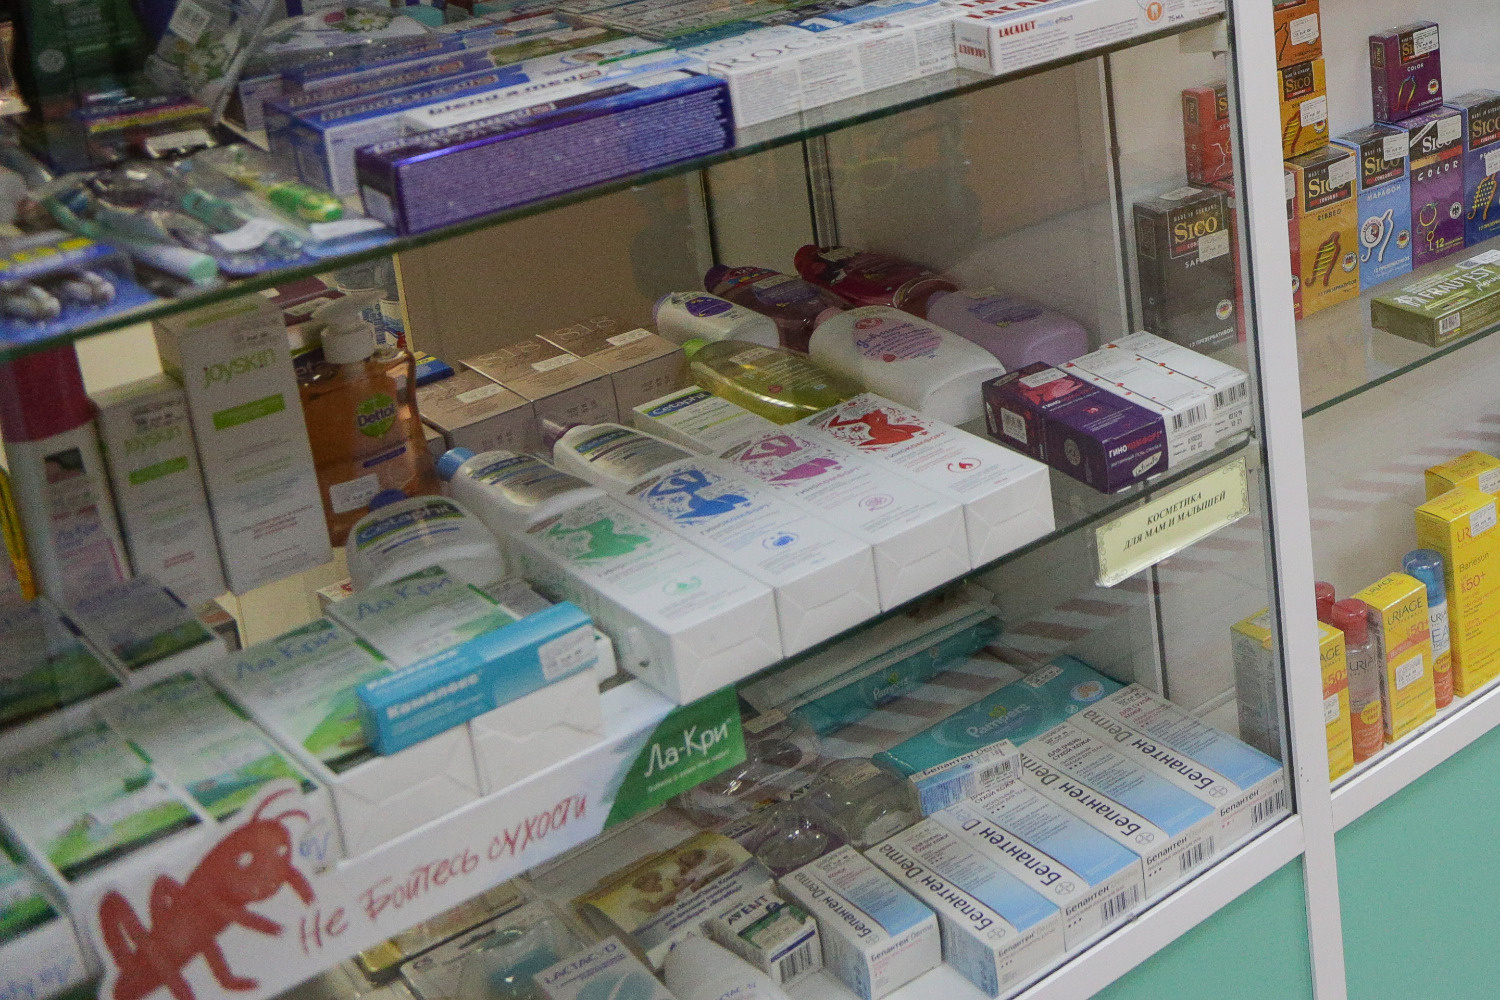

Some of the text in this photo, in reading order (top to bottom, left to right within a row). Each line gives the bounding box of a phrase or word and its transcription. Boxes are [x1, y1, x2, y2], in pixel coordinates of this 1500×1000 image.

[999, 20, 1036, 37] LACALUT
[1407, 63, 1424, 72] COLOR
[1417, 160, 1458, 182] COLOR
[1174, 216, 1217, 244] SICO
[1317, 209, 1342, 221] RIBBED
[1421, 267, 1496, 300] FRAUTEST
[356, 402, 397, 428] Dettol
[1123, 490, 1227, 551] ДЛЯ МАМ И МАЛЫШЕЙ
[1147, 491, 1202, 525] КОСМЕТИКА
[1387, 597, 1423, 626] URIAGE
[966, 703, 1031, 739] Pampers
[644, 719, 729, 778] Ла-Кри
[1083, 708, 1214, 788] Бепантен Derma
[1059, 771, 1144, 836] Бепантен
[1218, 787, 1261, 818] Бепантен
[979, 816, 1063, 886] Бепантен
[1145, 834, 1188, 866] Бепантен
[300, 792, 588, 955] Не Бойтесь сухости
[877, 843, 994, 934] Бепантен Derma
[1065, 884, 1111, 919] Бепантен
[819, 895, 872, 944] Бепантен
[870, 932, 910, 964] Бепантен
